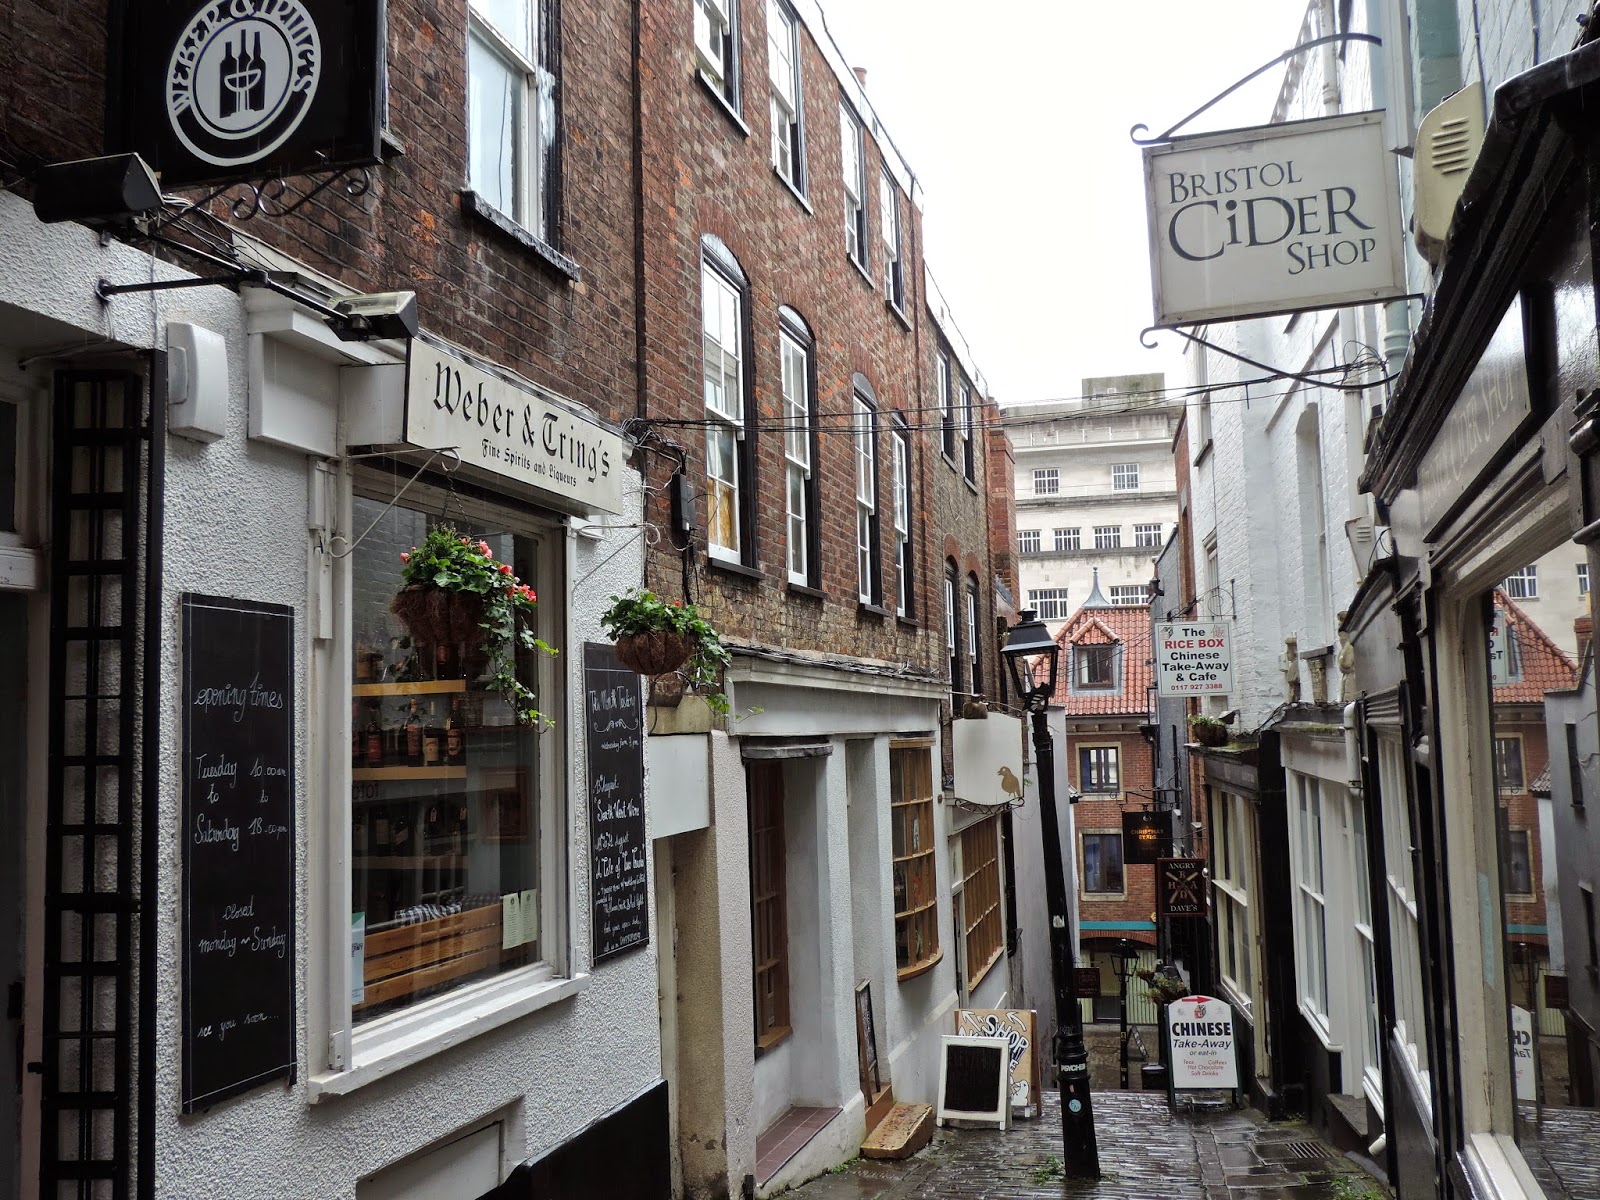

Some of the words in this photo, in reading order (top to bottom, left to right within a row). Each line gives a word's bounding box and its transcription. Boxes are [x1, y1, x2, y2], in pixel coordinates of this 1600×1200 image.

[1167, 160, 1302, 204] BRISTOL
[1287, 238, 1376, 275] SHOP
[433, 361, 514, 438] Weber
[522, 403, 535, 448] &
[542, 412, 610, 483] Tring's
[481, 438, 500, 458] Fine
[503, 447, 531, 470] Spirits
[534, 461, 546, 476] and
[548, 464, 577, 487] Liqueurs
[1182, 628, 1205, 637] The
[1165, 640, 1194, 649] RICE
[1198, 639, 1224, 648] BOX
[1162, 662, 1229, 671] Take-Away
[1170, 651, 1219, 661] Chinese
[1176, 673, 1184, 681] &
[1189, 672, 1217, 681] Cafe
[196, 753, 237, 788] Tuesday
[207, 783, 219, 804] to
[1170, 904, 1198, 912] DAVE'S
[251, 926, 286, 959] Sunday
[197, 1025, 212, 1037] see
[219, 1019, 236, 1041] you
[982, 1014, 1029, 1053] SHOP
[1172, 1022, 1231, 1036] CHINESE
[1173, 1039, 1231, 1050] Take-Away
